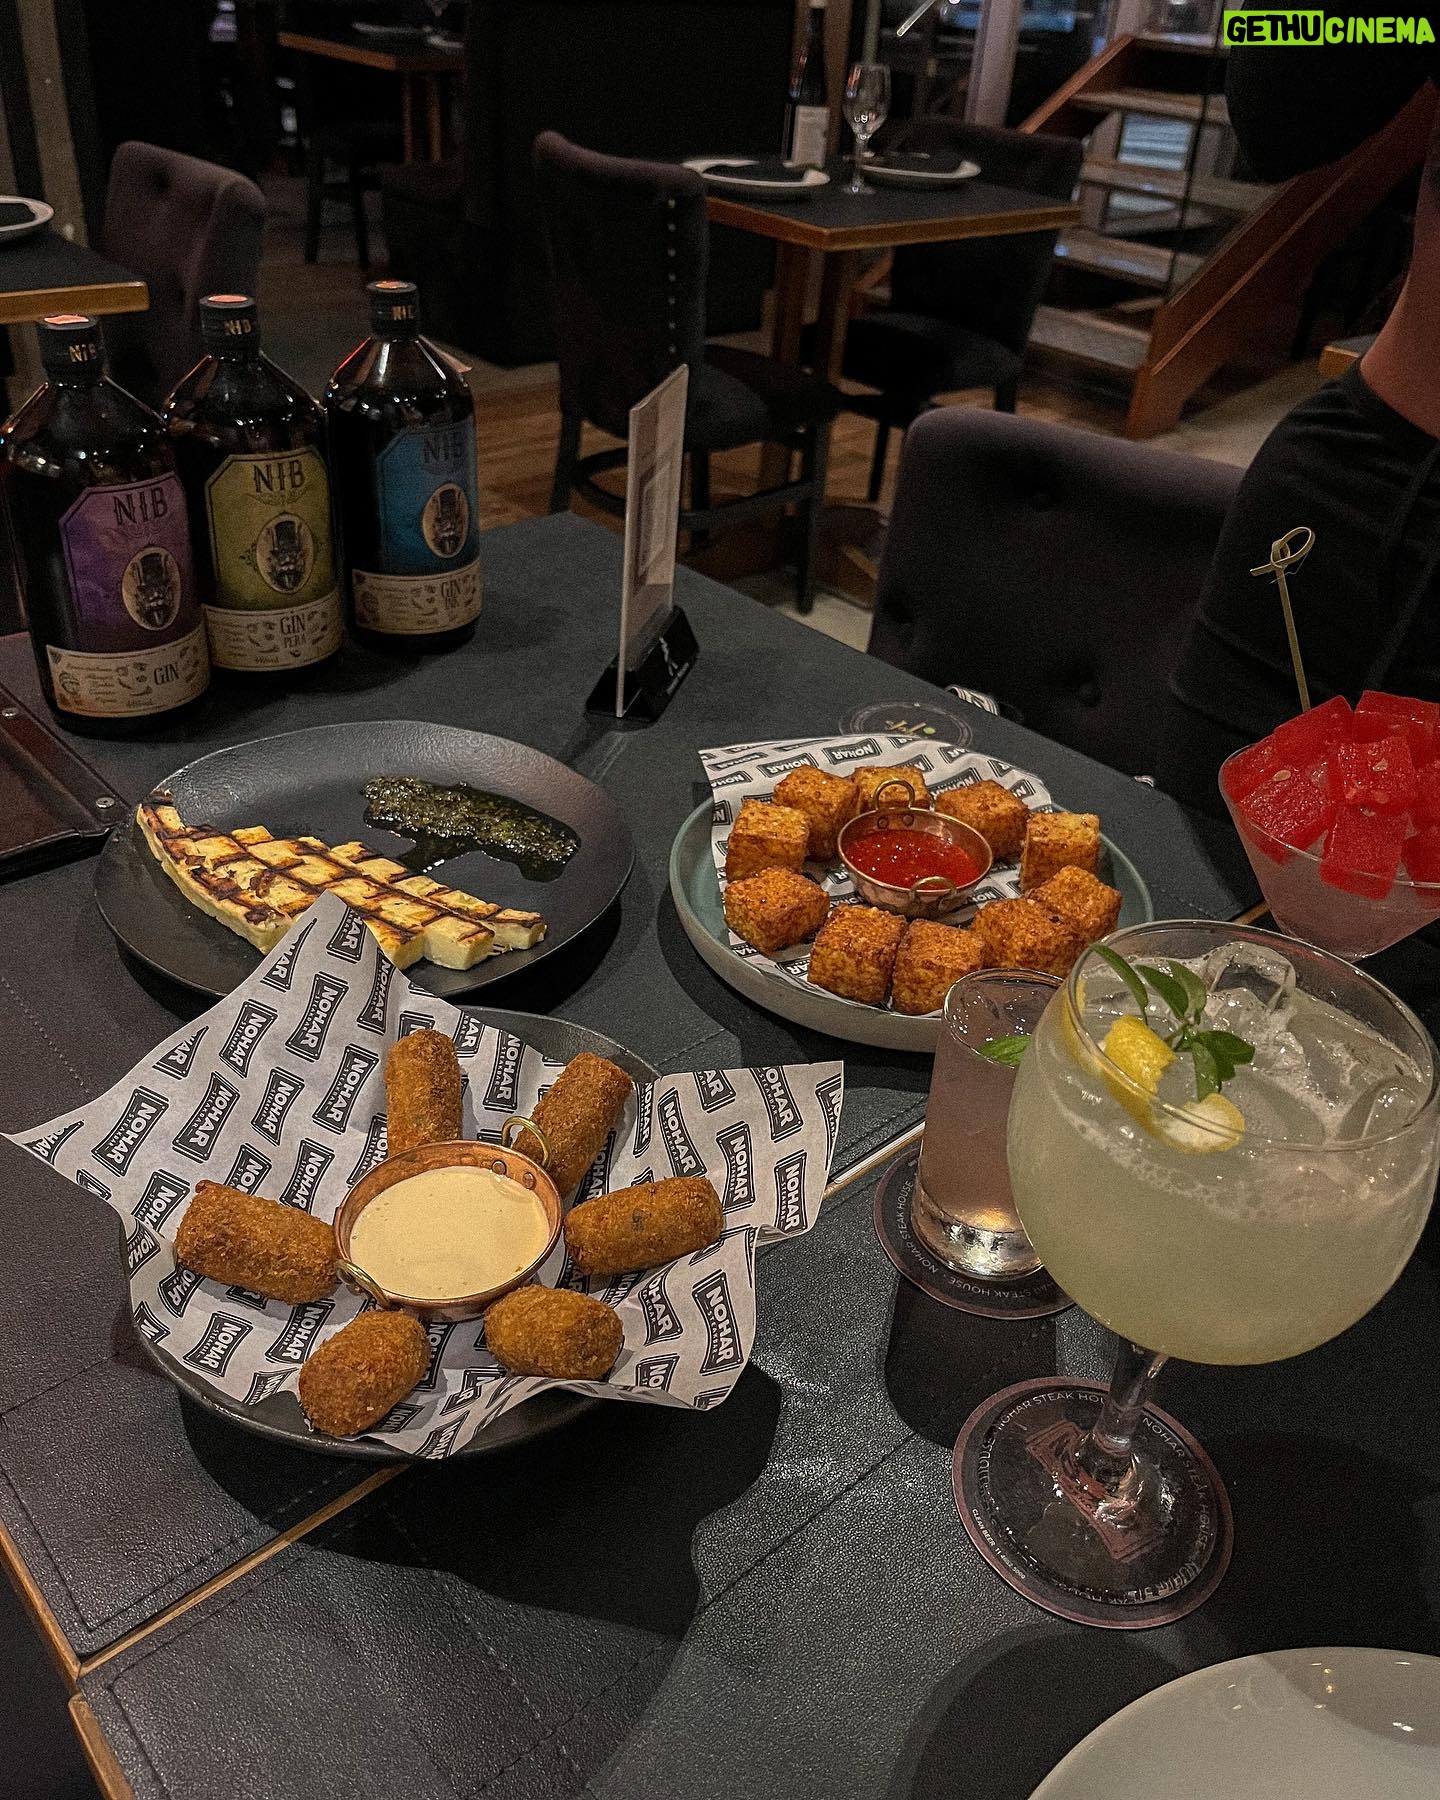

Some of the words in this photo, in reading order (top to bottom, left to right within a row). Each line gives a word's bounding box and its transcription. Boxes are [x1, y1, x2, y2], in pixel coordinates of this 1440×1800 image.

[253, 459, 305, 495] NIB
[112, 487, 169, 526] NIB
[280, 613, 306, 635] GIN
[153, 662, 180, 685] GIN
[766, 757, 812, 774] NOHAR
[832, 743, 874, 760] NOHAR
[711, 774, 745, 788] NOHA
[370, 958, 392, 1022] NOHAR
[230, 1012, 267, 1067] NOHAR
[300, 985, 339, 1048] NOHAR
[326, 1057, 369, 1122] NOHAR
[496, 1034, 521, 1100] NOHAR
[189, 1085, 233, 1147] NOHAR
[262, 1080, 295, 1135] NOHAR
[642, 1082, 653, 1143] NOHAR
[106, 1102, 158, 1165] NOHAR
[663, 1101, 697, 1173] NOHAR
[293, 1151, 326, 1210] NOHAR
[586, 1148, 607, 1199] OHAR
[730, 1135, 749, 1203] NOHAR
[896, 1180, 914, 1206] HOUSE
[784, 1162, 800, 1231] NOHAR
[896, 1208, 910, 1241] STEAK
[906, 1240, 939, 1275] NOHAR
[167, 1267, 197, 1305] OHAR
[648, 1276, 674, 1335] OHAR
[949, 1276, 991, 1296] HOUSE
[199, 1321, 242, 1370] NOHAR
[281, 1305, 324, 1360] NOHAR
[706, 1285, 735, 1364] NOHAR
[1032, 1391, 1076, 1406] STEAK
[1142, 1416, 1185, 1457] NOHAR
[971, 1508, 985, 1533] CLEAN
[982, 1529, 997, 1547] BEER
